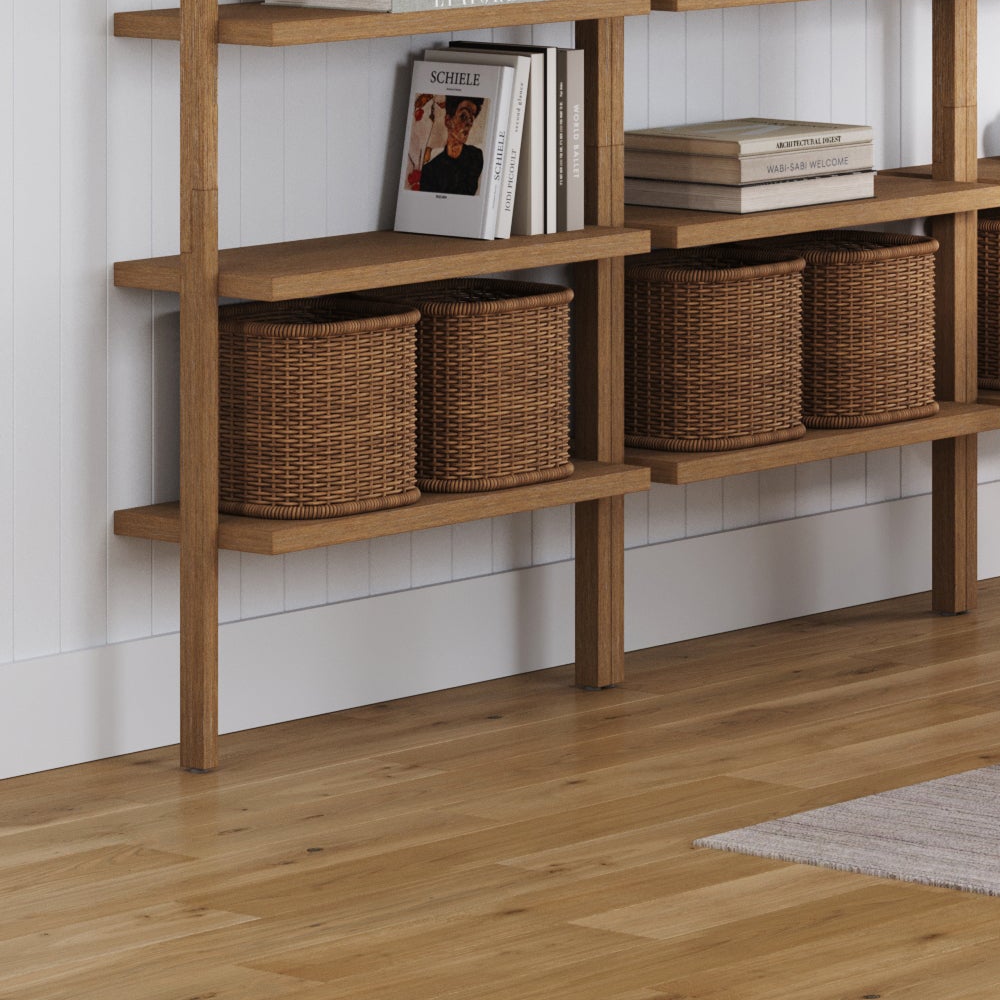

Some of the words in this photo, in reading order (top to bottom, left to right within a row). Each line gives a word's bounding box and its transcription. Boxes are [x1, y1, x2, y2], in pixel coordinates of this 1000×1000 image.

[430, 70, 481, 87] SCHIELE
[775, 137, 821, 149] ARCHITECTURAL
[822, 135, 841, 145] DIGEST
[494, 130, 506, 181] SCHIELE
[766, 162, 808, 174] WABI-SABI
[809, 156, 849, 170] WELCOME
[507, 148, 517, 188] PICOULT
[504, 191, 513, 212] JODI
